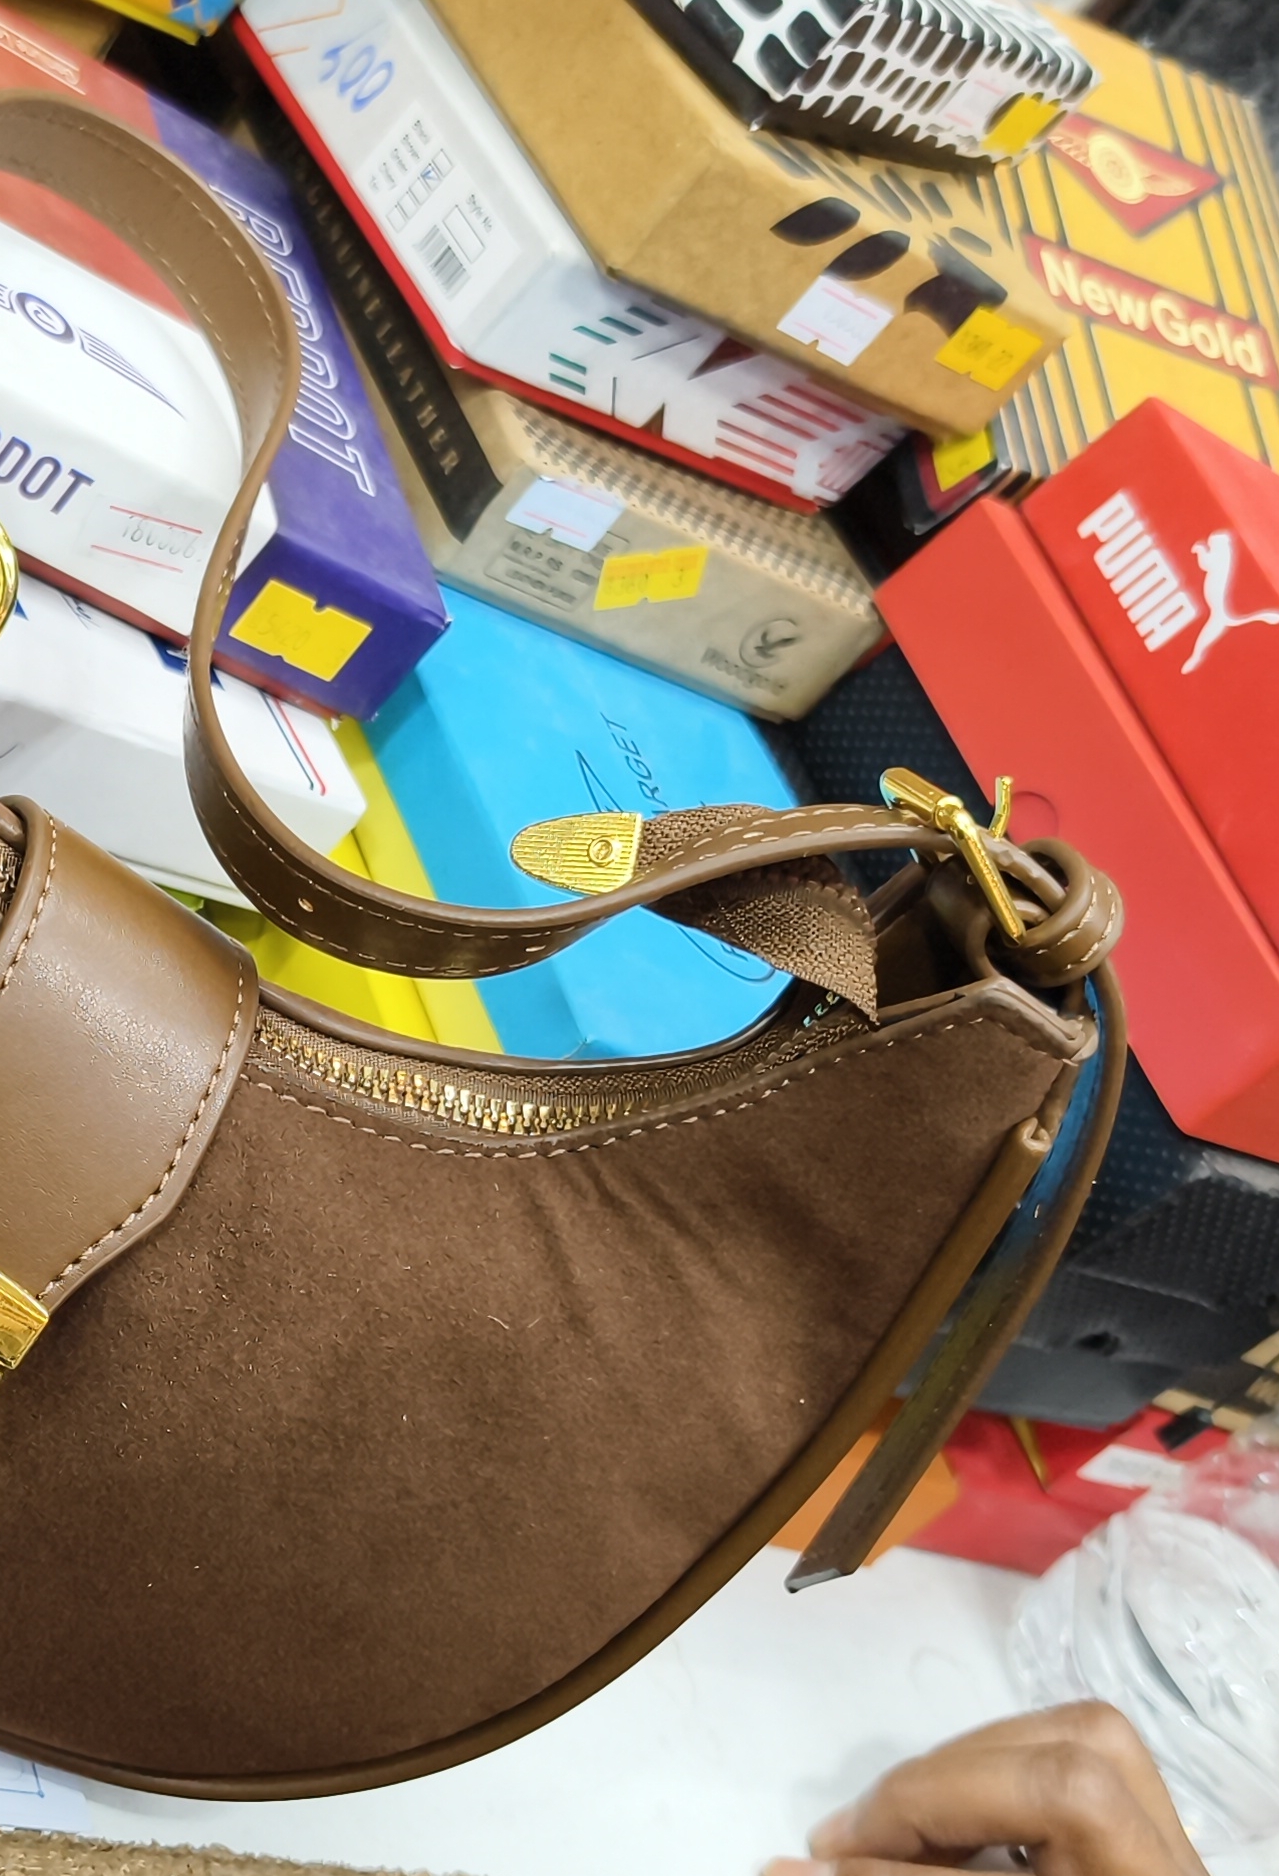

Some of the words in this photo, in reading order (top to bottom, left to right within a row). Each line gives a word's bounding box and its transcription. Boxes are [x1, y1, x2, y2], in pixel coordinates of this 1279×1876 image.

[1039, 244, 1266, 378] NewGold
[377, 321, 460, 476] LEATHER
[1076, 488, 1199, 653] PUMA
[599, 711, 671, 813] RGET
